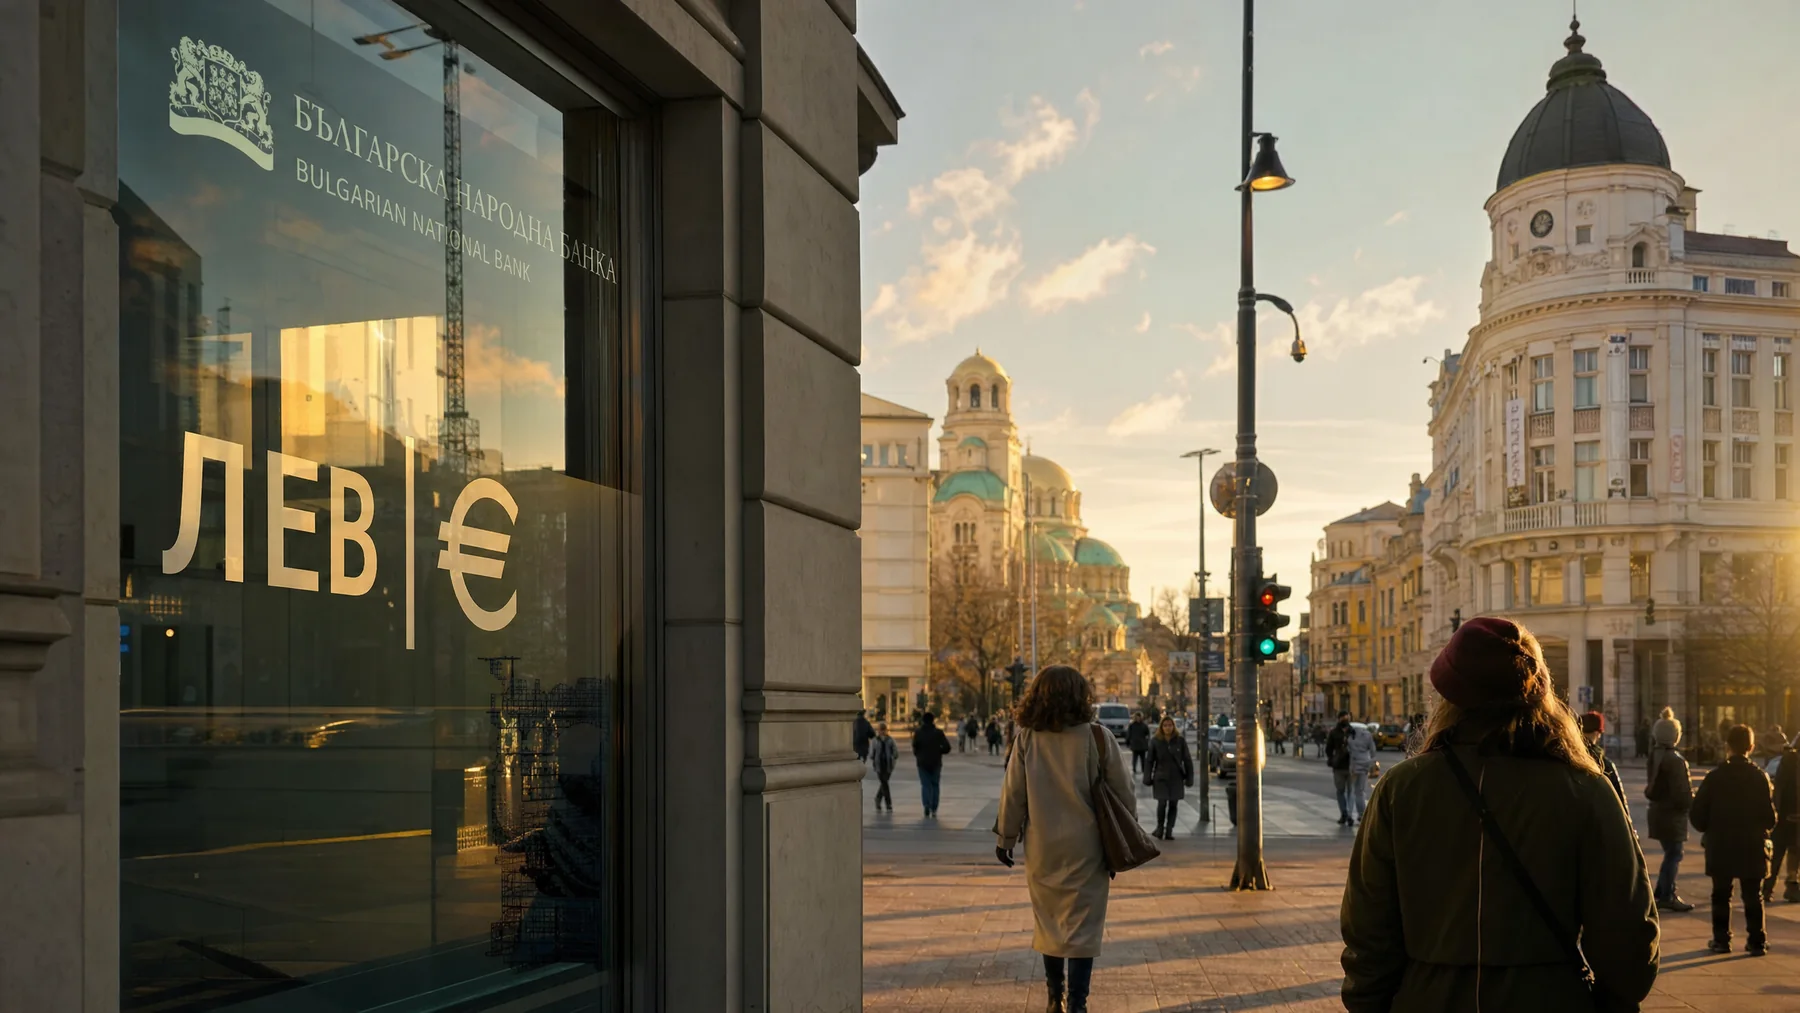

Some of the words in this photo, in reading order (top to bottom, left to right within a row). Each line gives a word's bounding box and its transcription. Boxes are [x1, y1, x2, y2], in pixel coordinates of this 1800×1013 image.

[293, 93, 450, 201] БЪЛГАРСКА
[455, 177, 555, 253] НАРОДНА
[559, 230, 618, 285] БАНКА
[296, 157, 406, 227] BULGARIAN
[412, 210, 490, 265] NATIONAL
[494, 248, 531, 283] BANK
[161, 430, 378, 597] ЛЕВ
[437, 477, 519, 632] €
